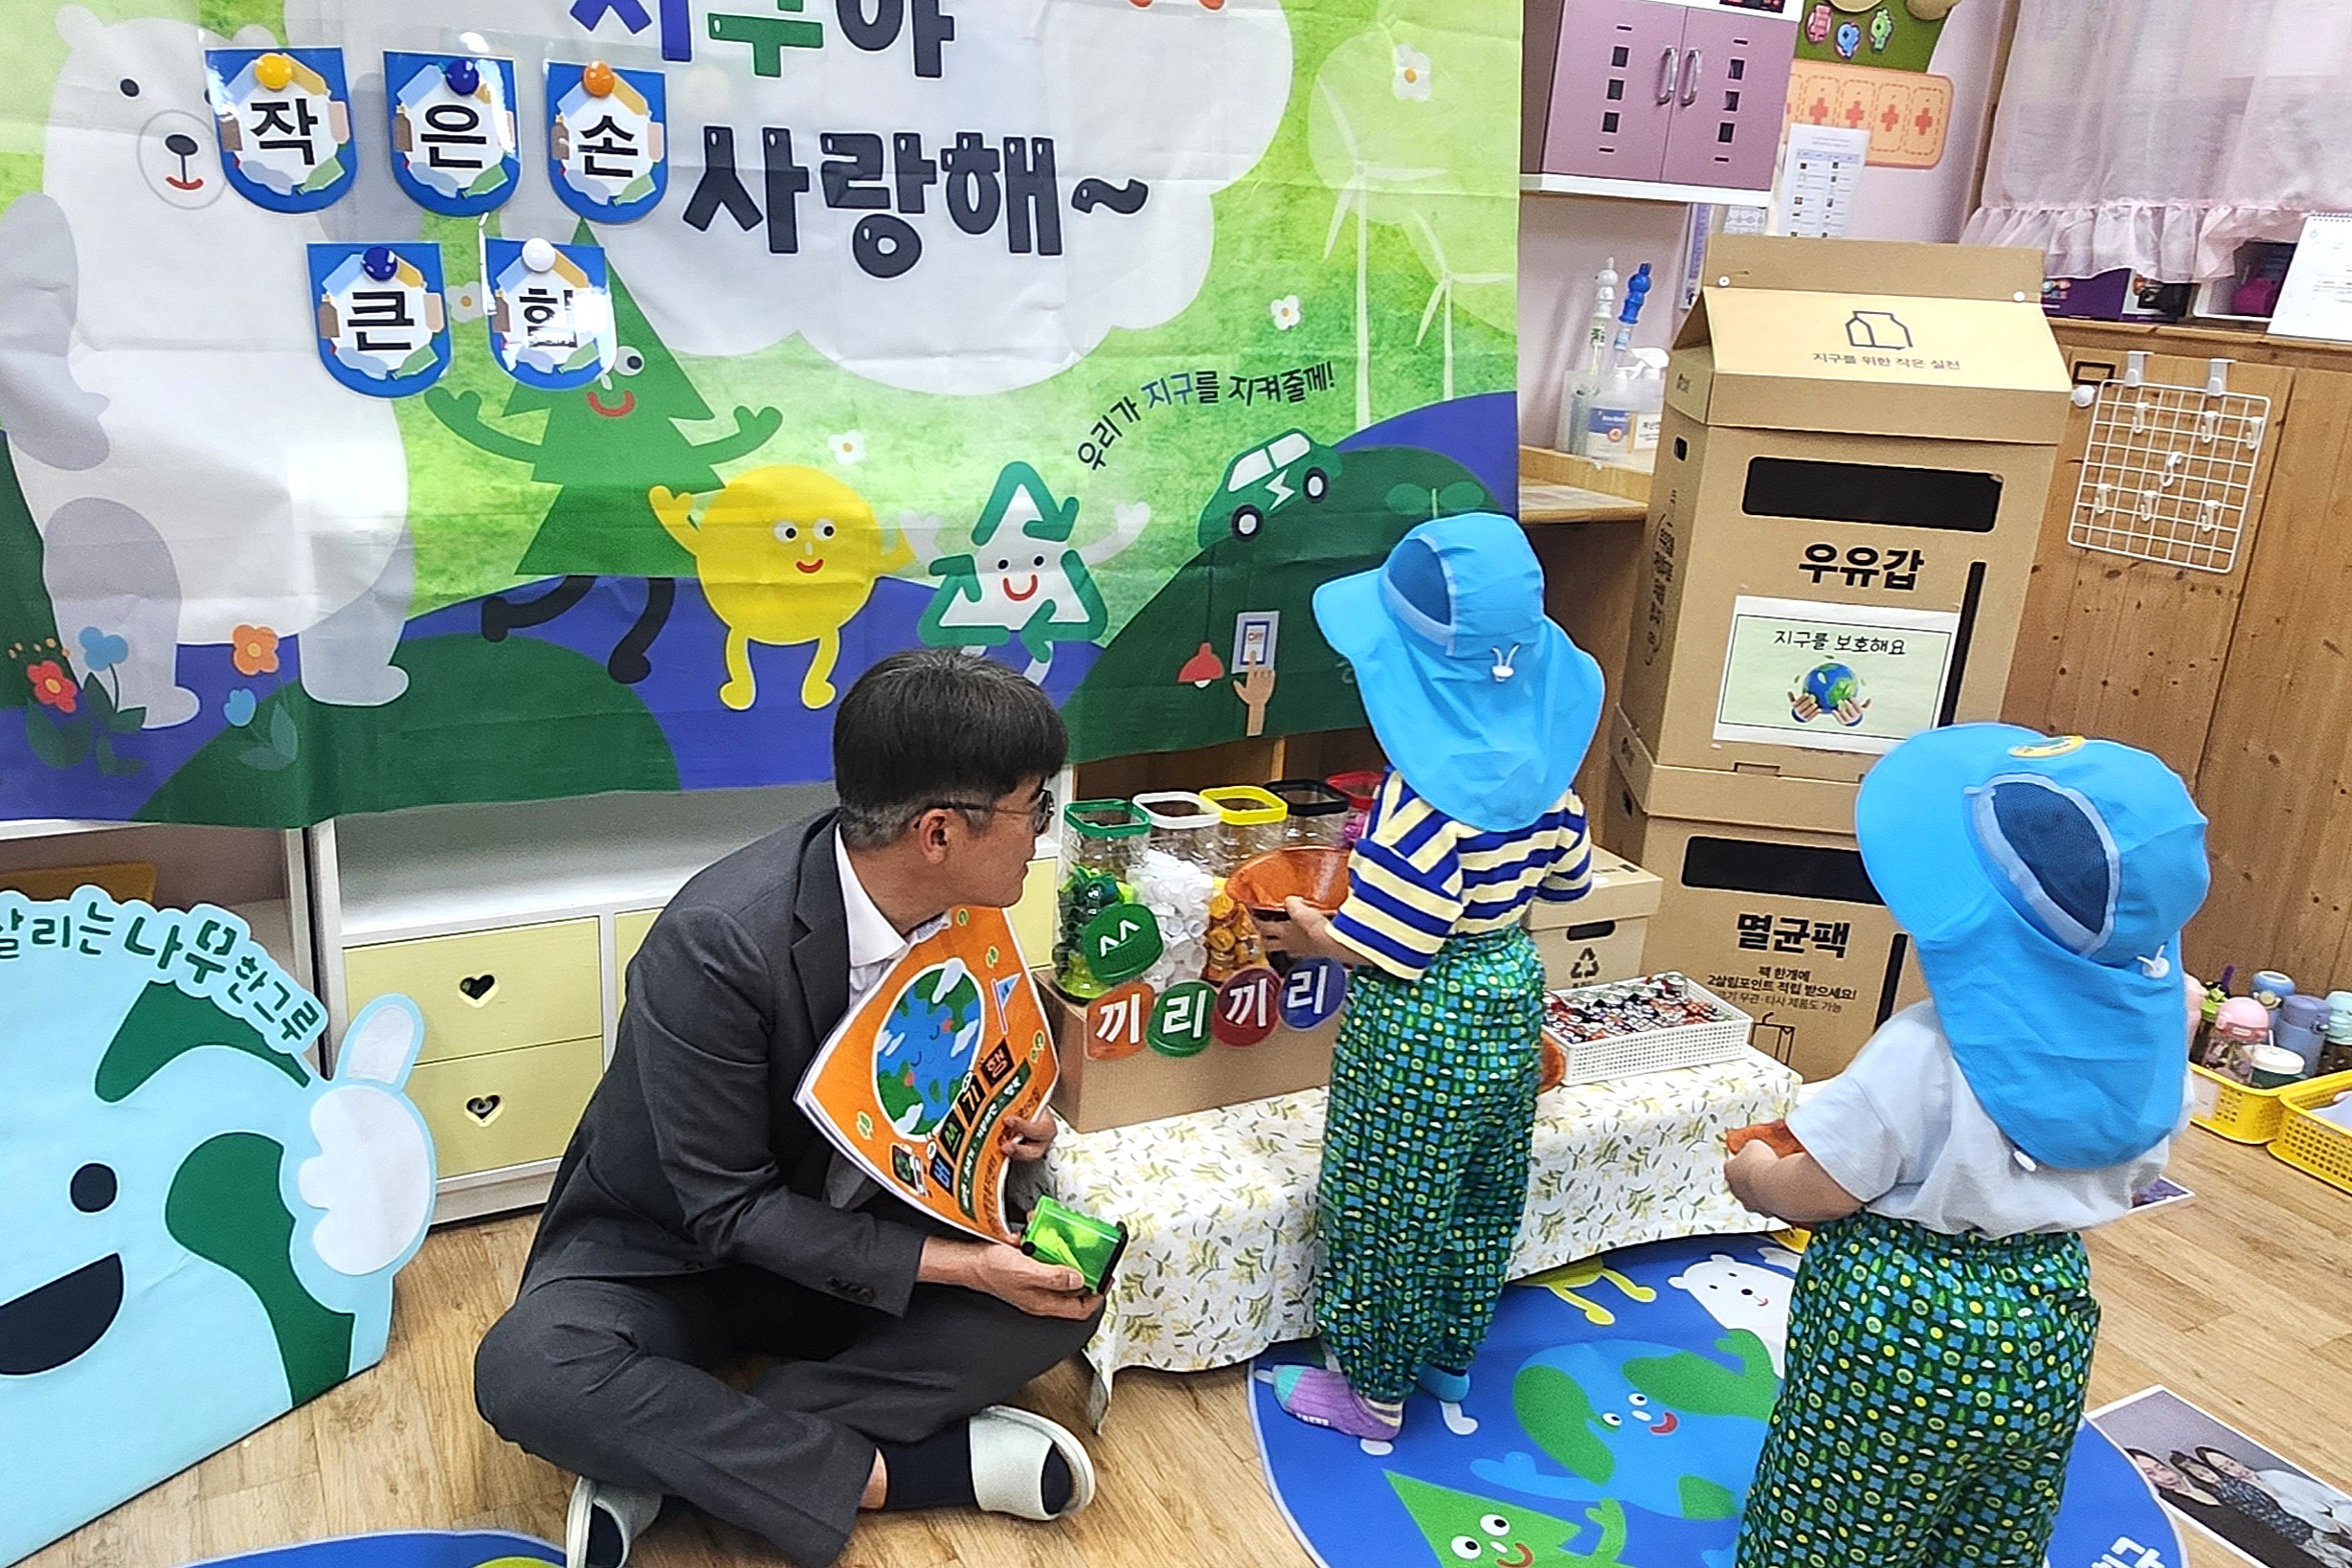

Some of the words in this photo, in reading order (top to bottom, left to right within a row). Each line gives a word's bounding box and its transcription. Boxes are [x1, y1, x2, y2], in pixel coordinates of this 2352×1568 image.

[682, 124, 1150, 280] 사랑해~
[347, 289, 415, 352] 큰
[1812, 352, 1858, 365] 지구를
[1077, 395, 1142, 471] 우리가
[1139, 370, 1221, 410] 지구를
[1797, 543, 1926, 592] 우유갑
[1774, 630, 1830, 651] 지구를
[1833, 635, 1907, 656] 보호해요
[1736, 912, 1851, 959] 멸균팩
[1706, 974, 1775, 993] 2살림포인트
[1777, 981, 1803, 997] 적립
[1803, 984, 1858, 1001] 받으세요!
